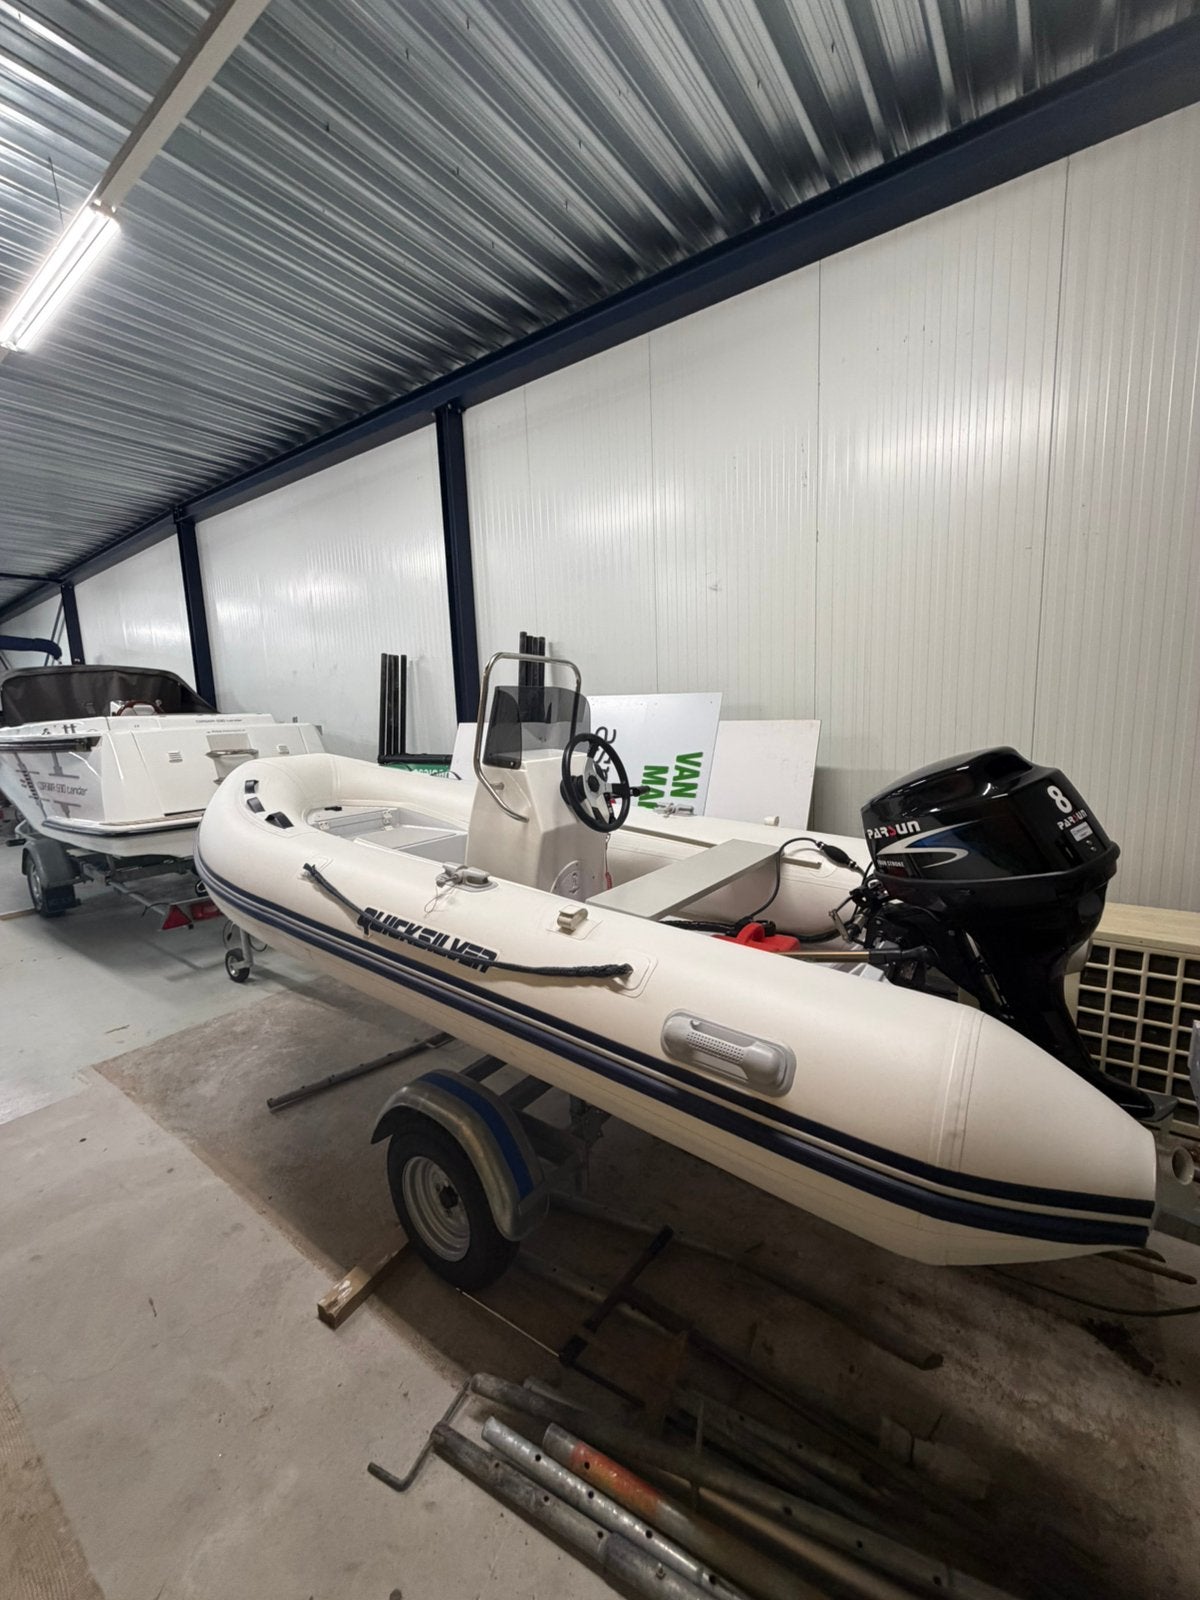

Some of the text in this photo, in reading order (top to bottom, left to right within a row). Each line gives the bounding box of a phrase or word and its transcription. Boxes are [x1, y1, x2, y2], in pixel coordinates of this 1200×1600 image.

[670, 751, 704, 799] VAN
[1047, 785, 1073, 814] 8
[867, 820, 921, 839] PARSUN
[1056, 809, 1088, 831] PARSUN
[357, 906, 498, 974] QUICKSILVER
